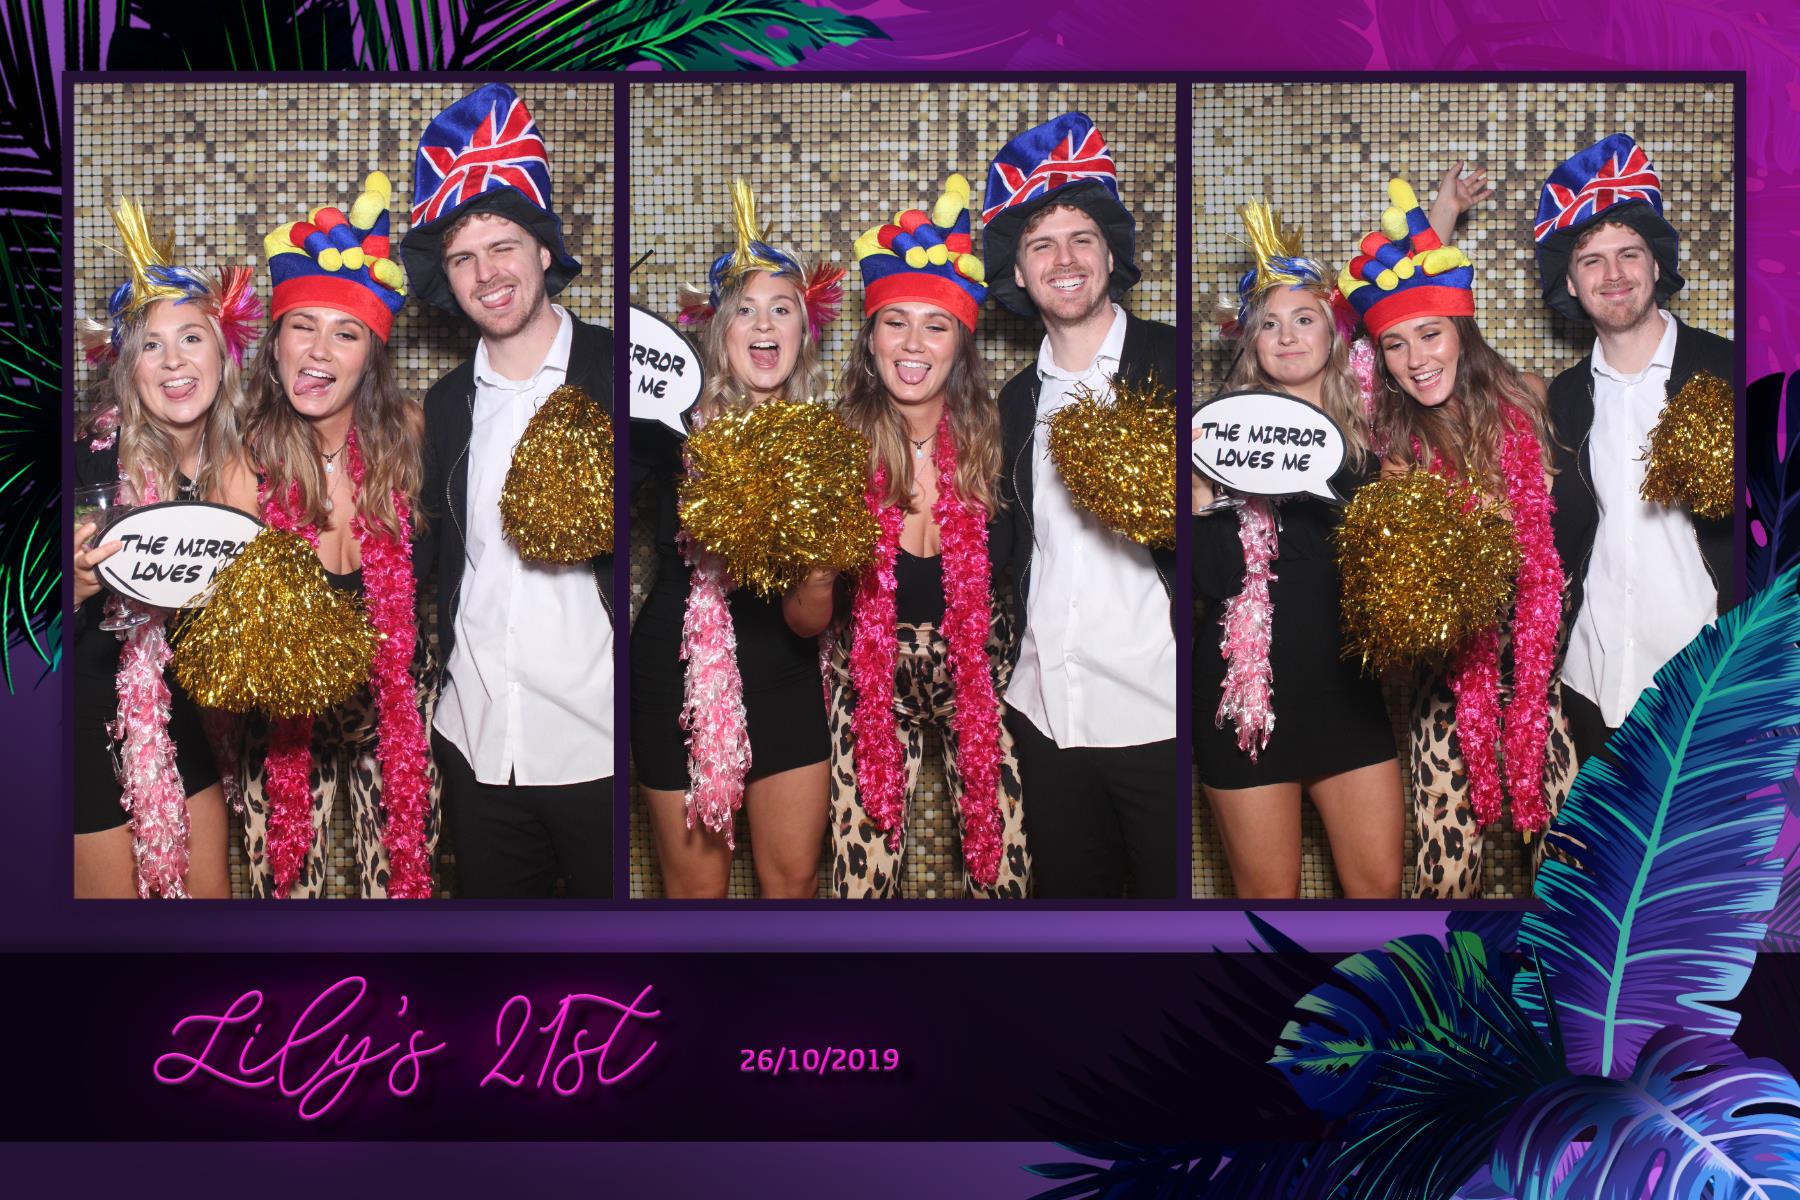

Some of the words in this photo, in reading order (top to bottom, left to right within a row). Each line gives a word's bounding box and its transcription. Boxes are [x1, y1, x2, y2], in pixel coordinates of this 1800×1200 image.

[630, 343, 686, 377] RROR
[638, 375, 668, 398] ME
[1202, 422, 1241, 442] THE
[1248, 425, 1327, 447] MIRROR
[1216, 448, 1275, 470] LOVES
[1282, 453, 1311, 472] ME
[120, 534, 168, 555] THE
[174, 537, 246, 559] MIRRO
[131, 562, 202, 583] LOVES
